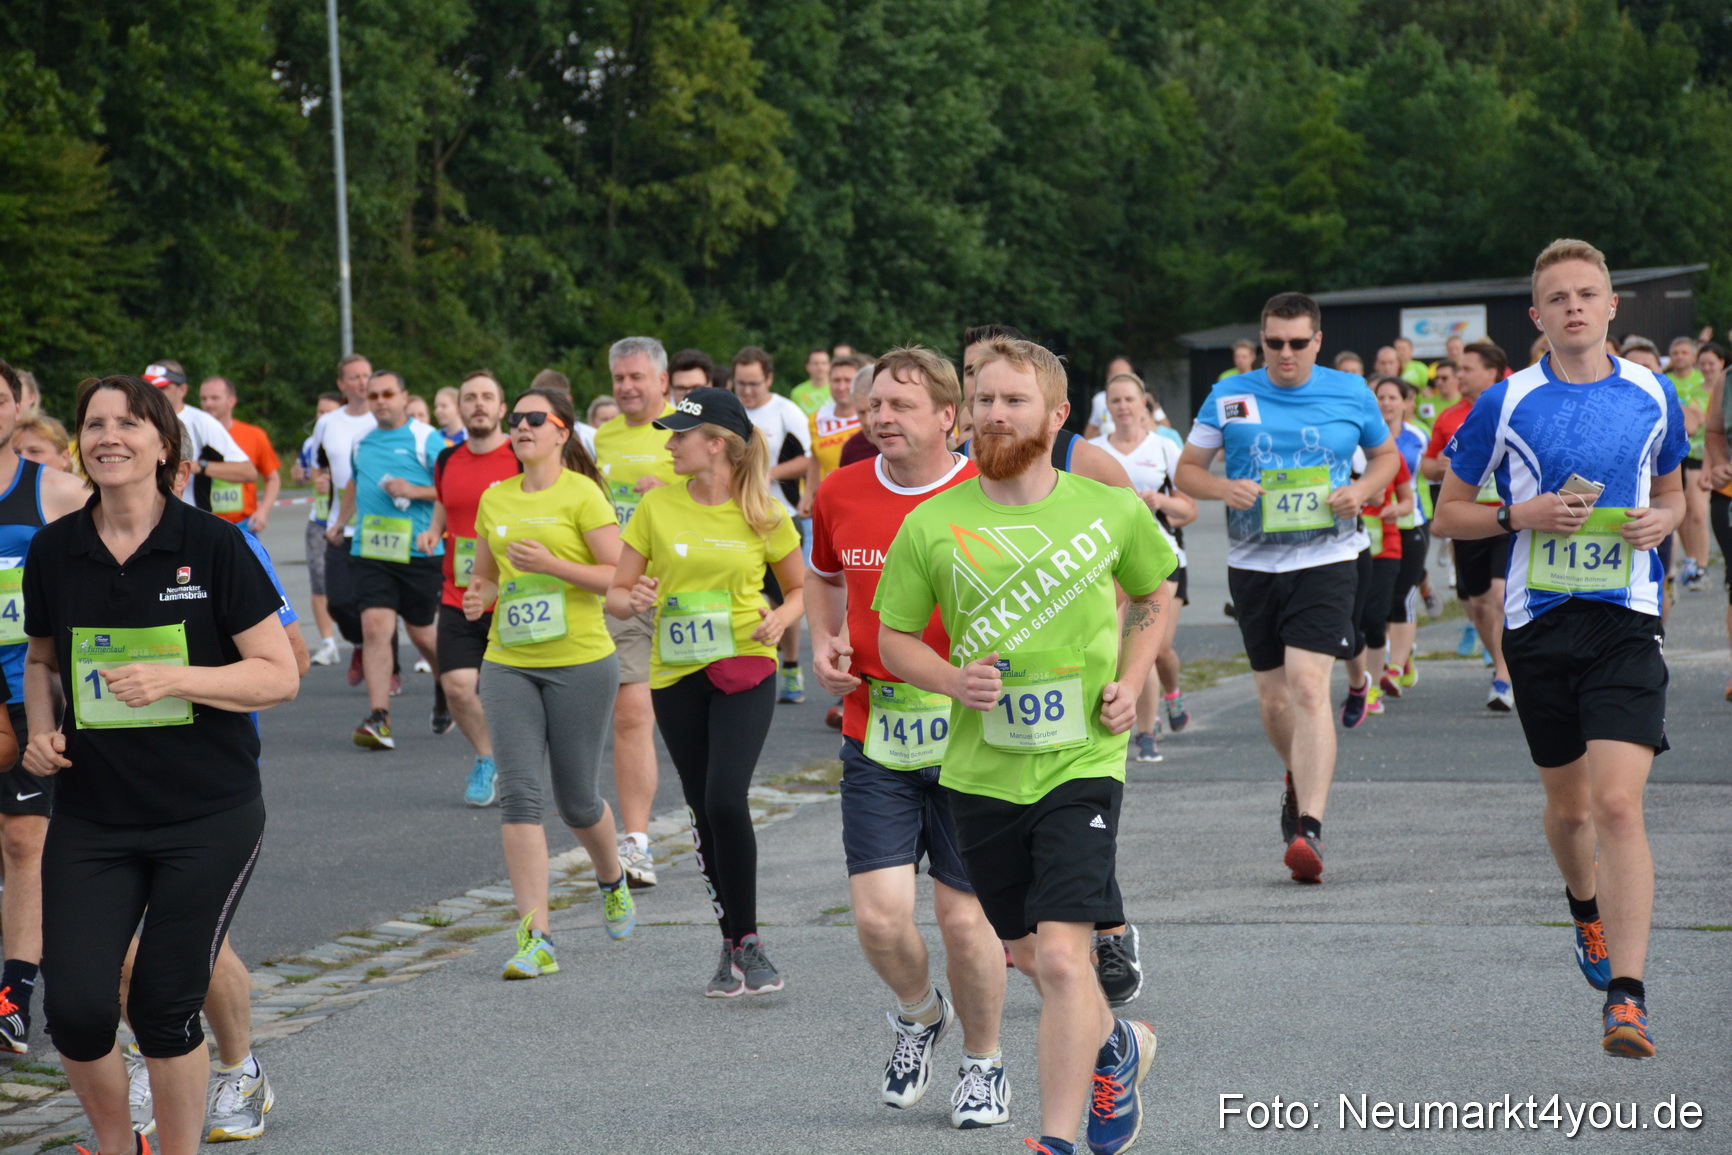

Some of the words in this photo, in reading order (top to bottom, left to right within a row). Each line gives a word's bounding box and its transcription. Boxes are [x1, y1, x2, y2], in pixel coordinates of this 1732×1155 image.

[1276, 491, 1319, 513] 473
[370, 534, 400, 550] 417
[1542, 539, 1622, 570] 1134
[159, 590, 208, 602] Lammsbräu
[166, 585, 201, 593] Neumarkter
[1004, 626, 1031, 651] UND
[1031, 546, 1119, 630] GEBÄUDETECHNIK
[507, 600, 551, 627] 632
[669, 618, 715, 645] 611
[998, 689, 1065, 726] 198
[879, 714, 949, 745] 1410
[1009, 732, 1033, 740] Manuel
[1034, 730, 1058, 739] Gruber
